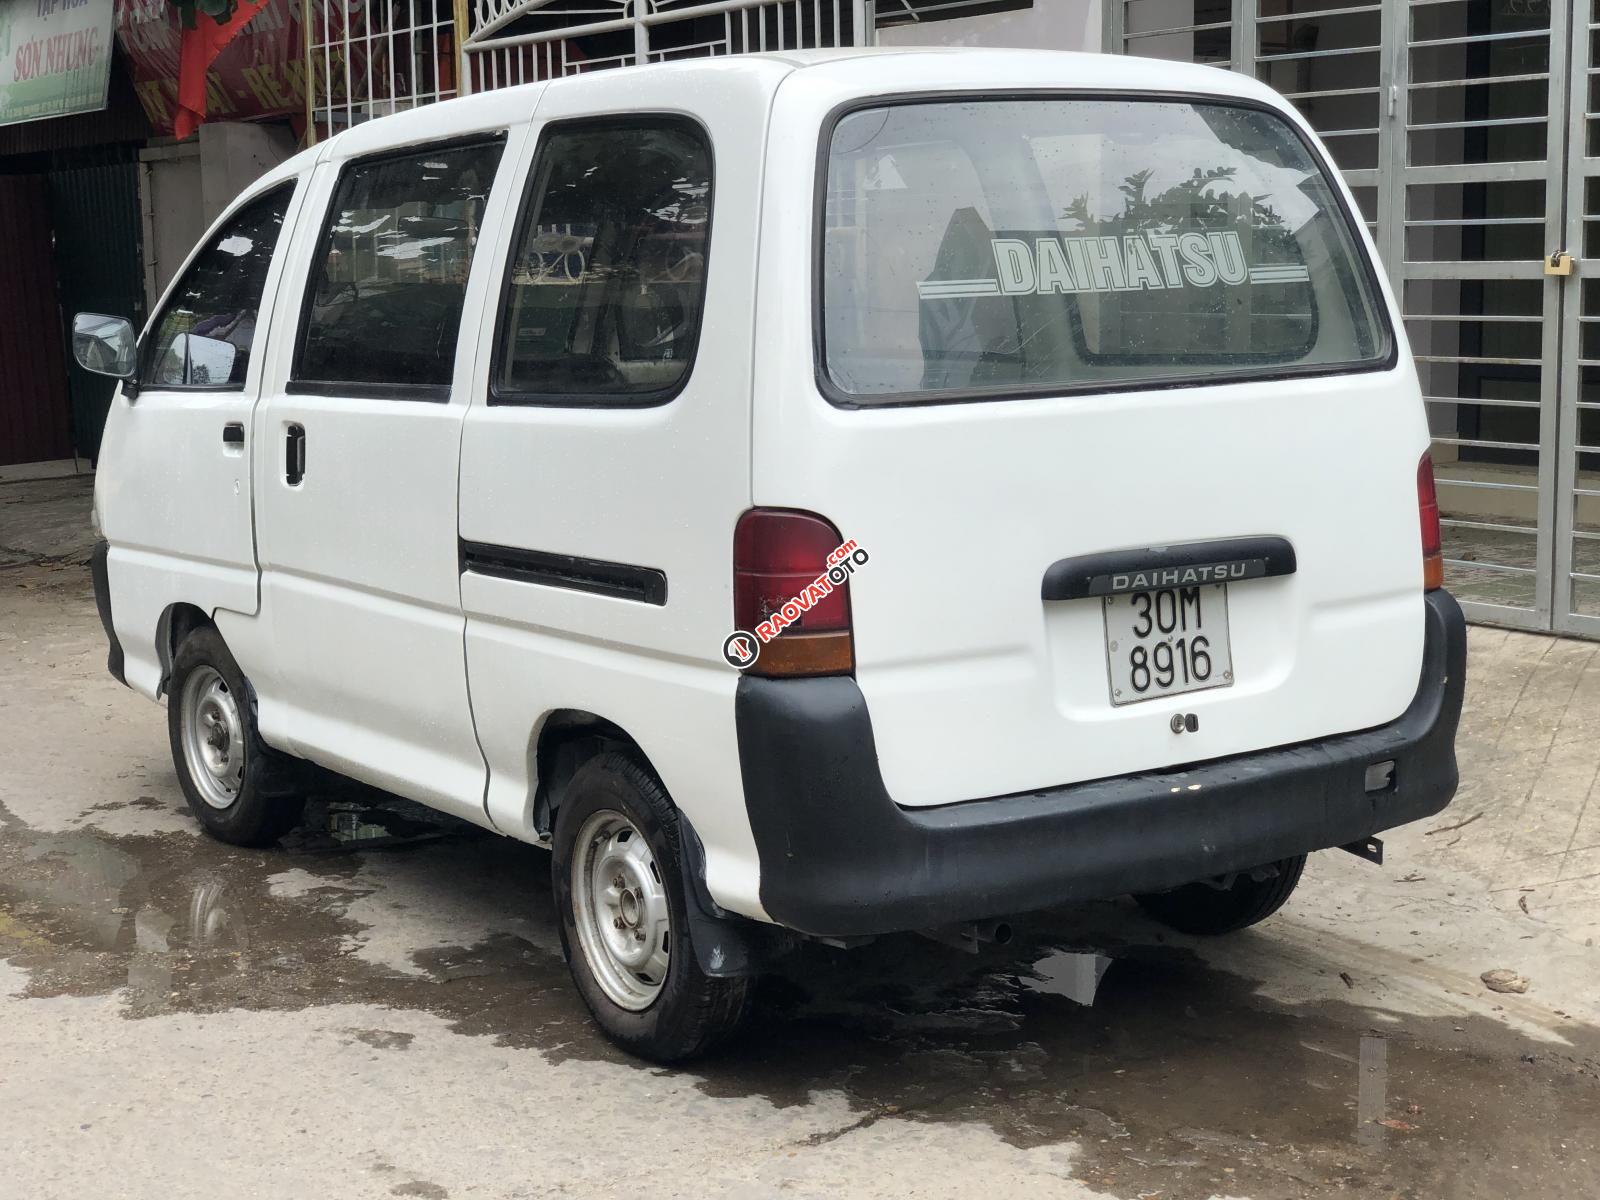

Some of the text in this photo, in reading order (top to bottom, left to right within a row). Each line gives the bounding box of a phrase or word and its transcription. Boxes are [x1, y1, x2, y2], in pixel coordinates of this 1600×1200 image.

[44, 26, 98, 76] NHUNG
[991, 231, 1248, 296] DAIHATSU
[1112, 562, 1246, 590] DAIHATSU
[1130, 585, 1202, 639] 30M
[1129, 635, 1212, 693] 8916
